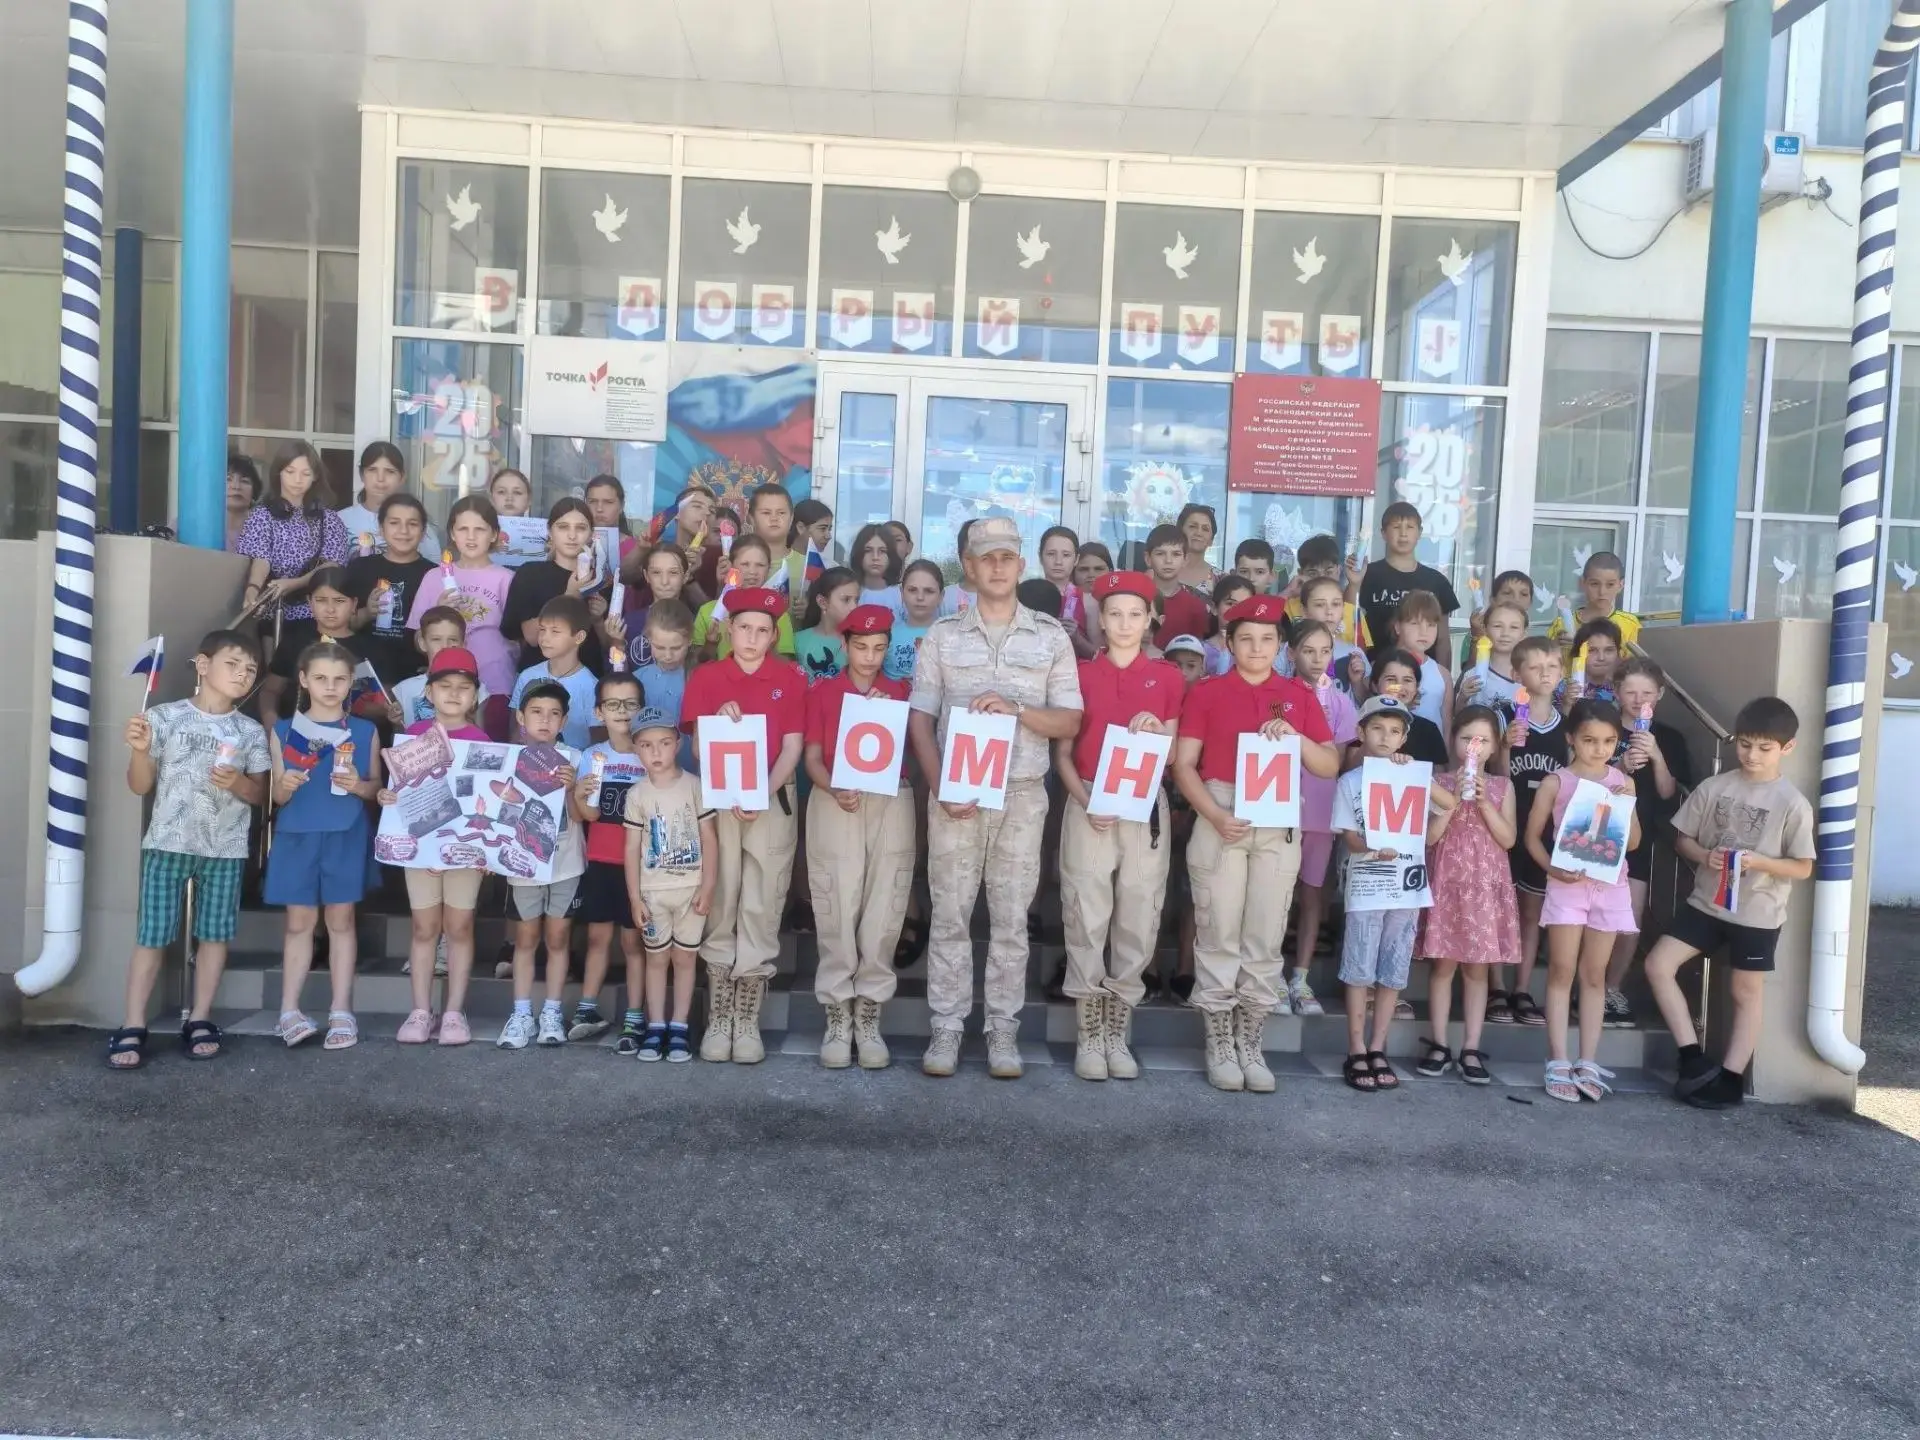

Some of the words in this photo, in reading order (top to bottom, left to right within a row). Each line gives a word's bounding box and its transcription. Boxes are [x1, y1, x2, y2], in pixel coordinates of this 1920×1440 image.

[546, 372, 586, 383] ТОЧКА
[608, 376, 645, 387] РОСТА
[1312, 401, 1360, 409] ФЕДЕРАЦИЯ
[1406, 432, 1464, 488] 20
